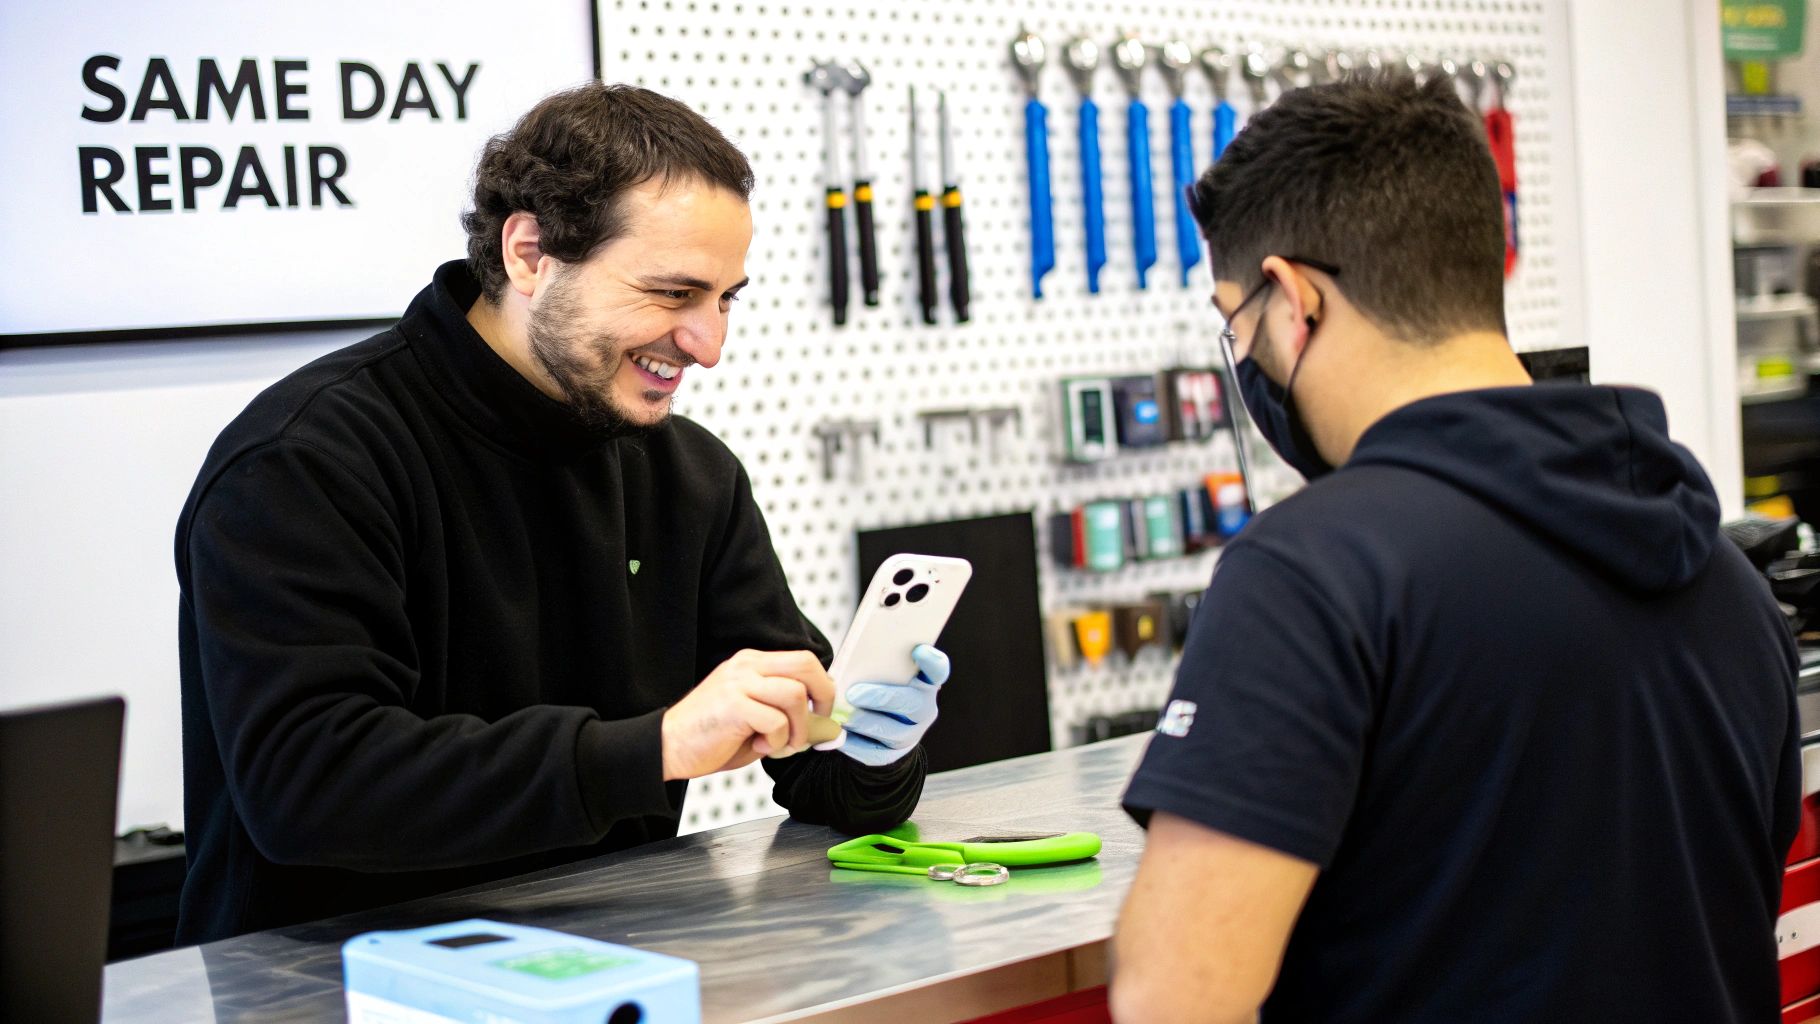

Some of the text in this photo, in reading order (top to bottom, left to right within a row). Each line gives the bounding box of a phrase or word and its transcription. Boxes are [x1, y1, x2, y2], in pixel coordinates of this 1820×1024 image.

[81, 54, 480, 123] SAME DAY
[78, 145, 353, 213] REPAIR
